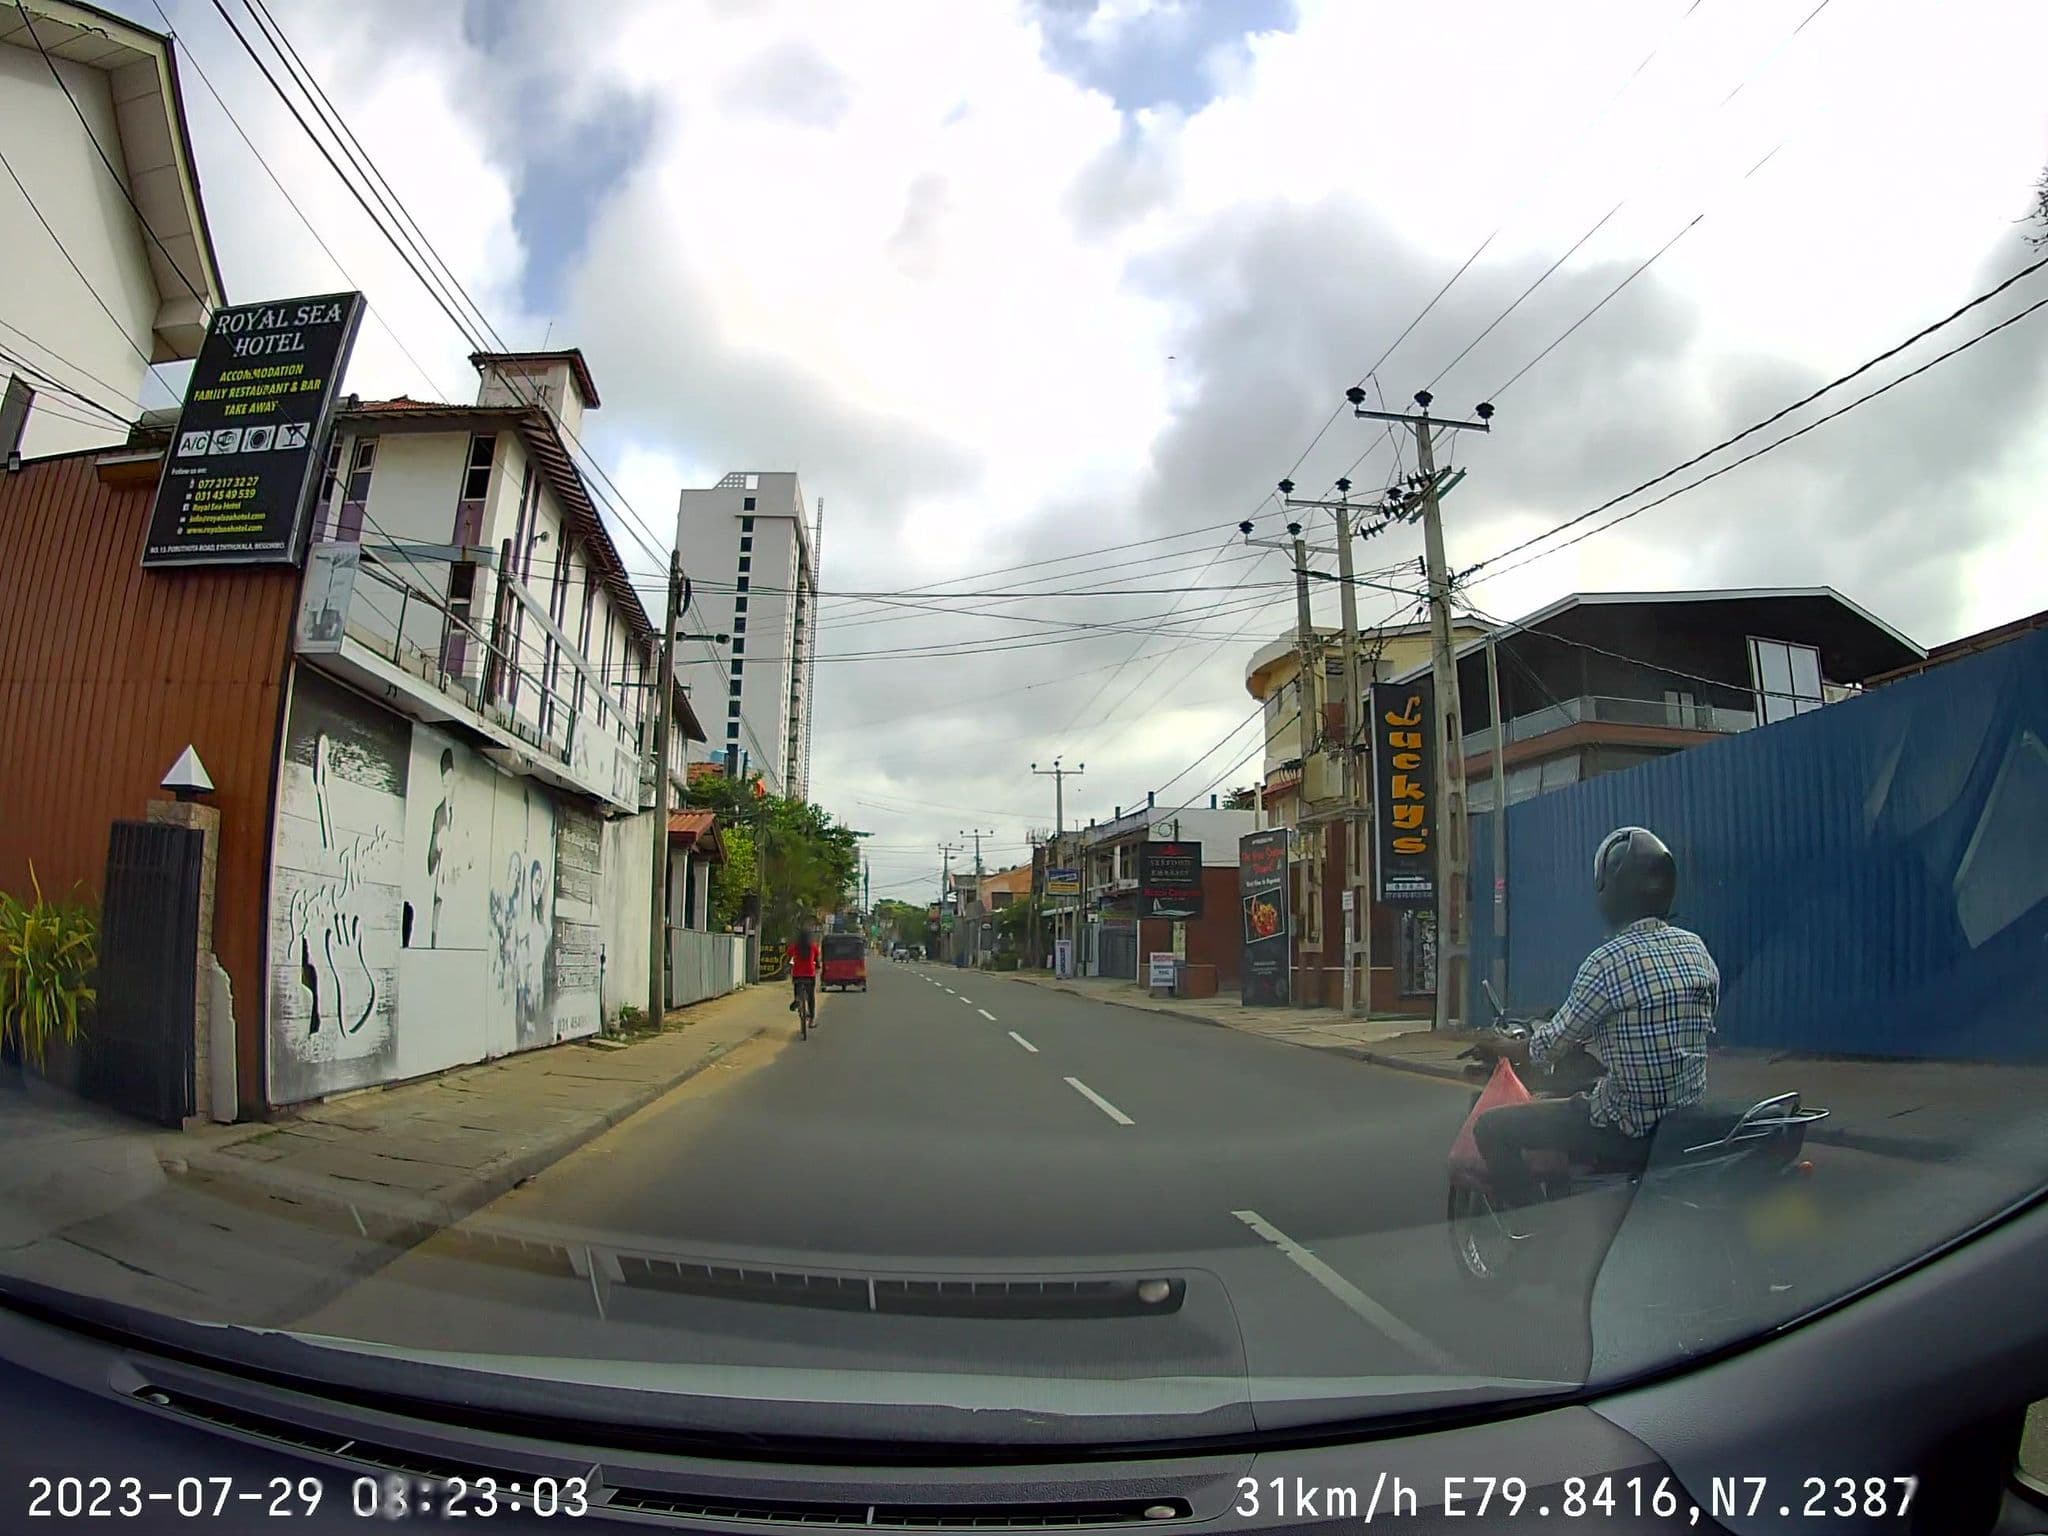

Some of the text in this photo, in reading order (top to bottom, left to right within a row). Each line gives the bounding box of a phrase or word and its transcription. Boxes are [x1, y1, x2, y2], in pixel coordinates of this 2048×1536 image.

[215, 303, 342, 334] ROYAL SEA
[233, 333, 304, 357] HOTEL
[219, 364, 304, 382] ACCOMMODATION
[194, 379, 321, 401] FAMILY RESTAURANT & BAR
[224, 401, 279, 416] TAKE AWAY
[181, 436, 207, 450] A/C
[198, 480, 216, 489] 077
[216, 478, 234, 488] 217
[195, 488, 256, 501] 031 45 49 539
